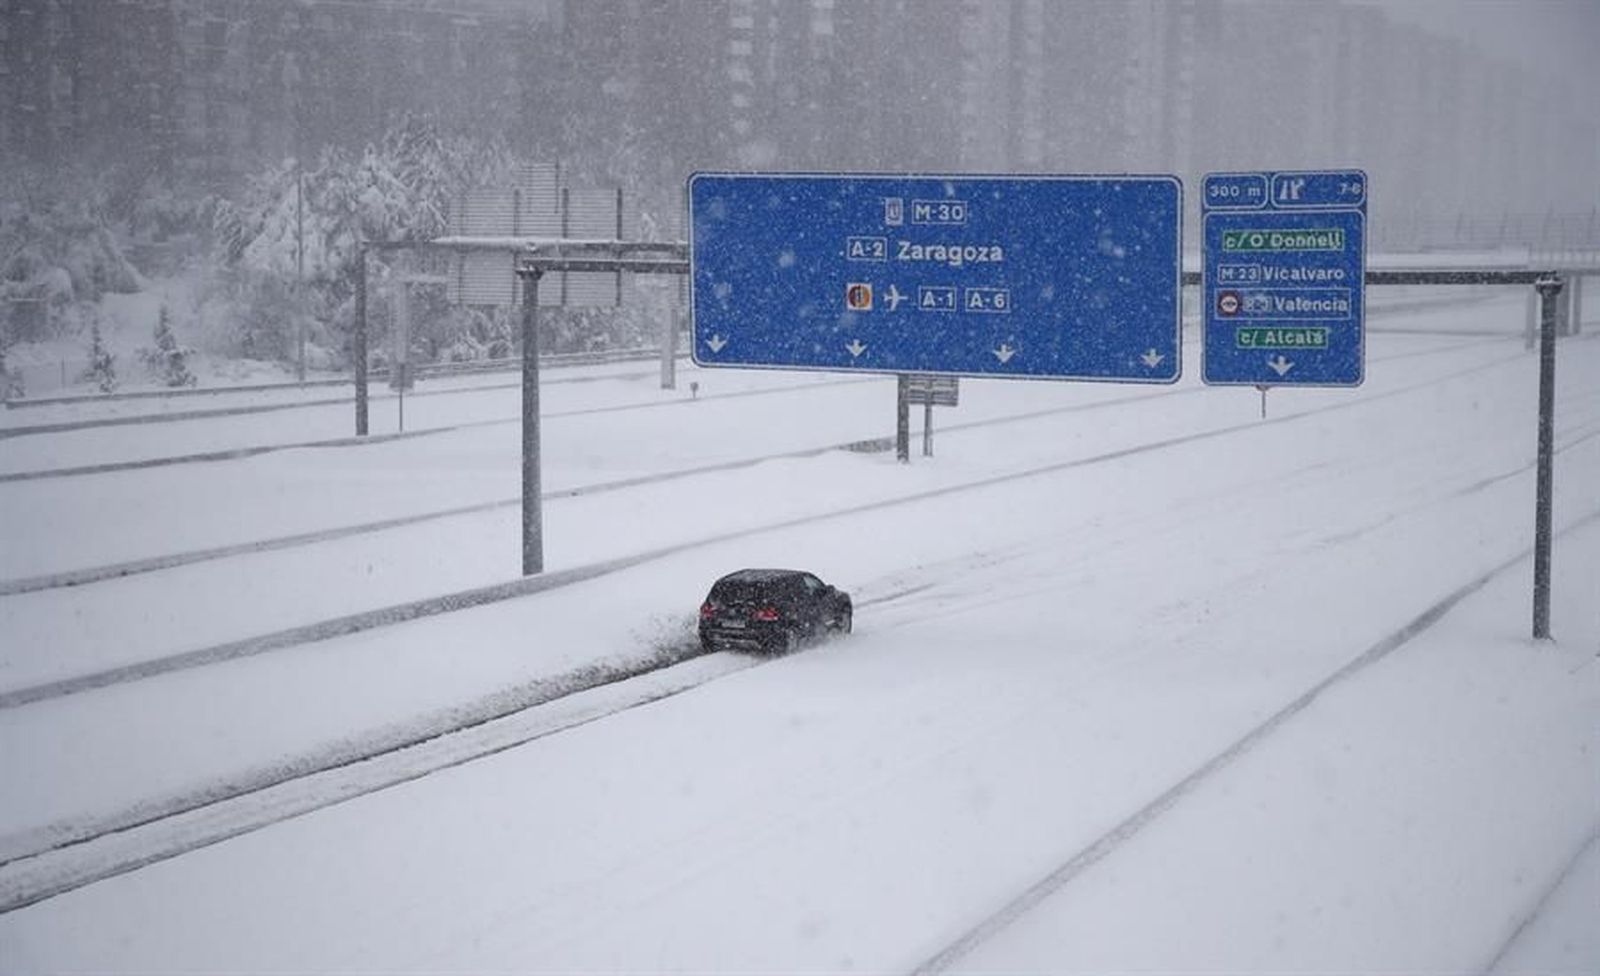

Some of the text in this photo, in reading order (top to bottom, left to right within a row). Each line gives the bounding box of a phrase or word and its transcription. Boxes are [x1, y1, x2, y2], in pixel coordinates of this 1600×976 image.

[1209, 184, 1262, 197] 300 m
[915, 204, 964, 220] M-30
[851, 241, 1004, 266] A-2 Zaragoza
[1262, 266, 1345, 280] Vicalvaro
[922, 290, 1006, 309] A-1 A-6
[1274, 296, 1348, 311] Valencia
